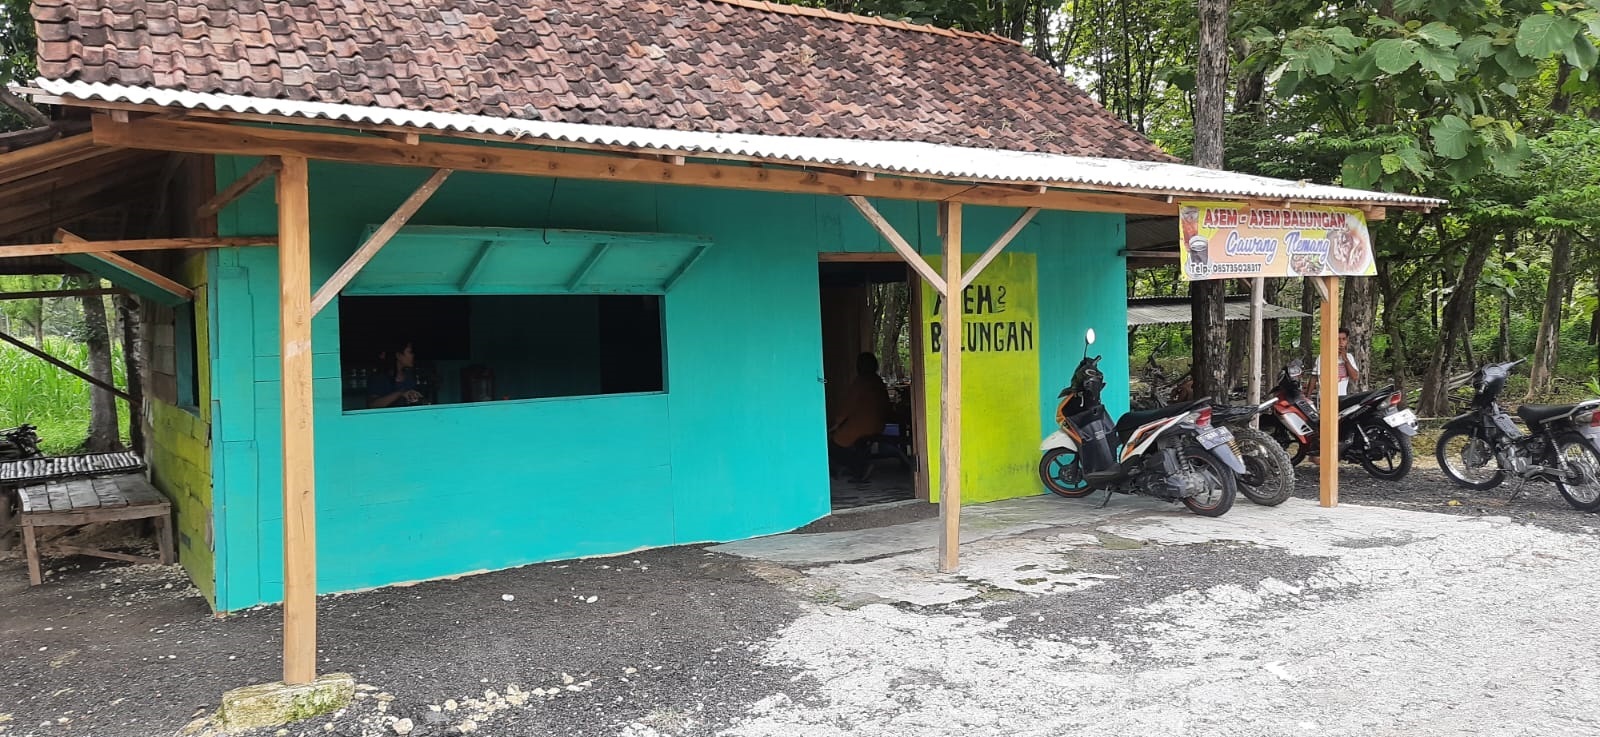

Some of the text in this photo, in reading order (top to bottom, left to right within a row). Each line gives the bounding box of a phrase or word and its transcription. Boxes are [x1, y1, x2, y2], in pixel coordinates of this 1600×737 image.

[1203, 208, 1238, 226] ASEM
[1249, 209, 1281, 226] ASEM
[1282, 210, 1346, 228] BALUNGAN
[930, 321, 1033, 353] BUNGAN
